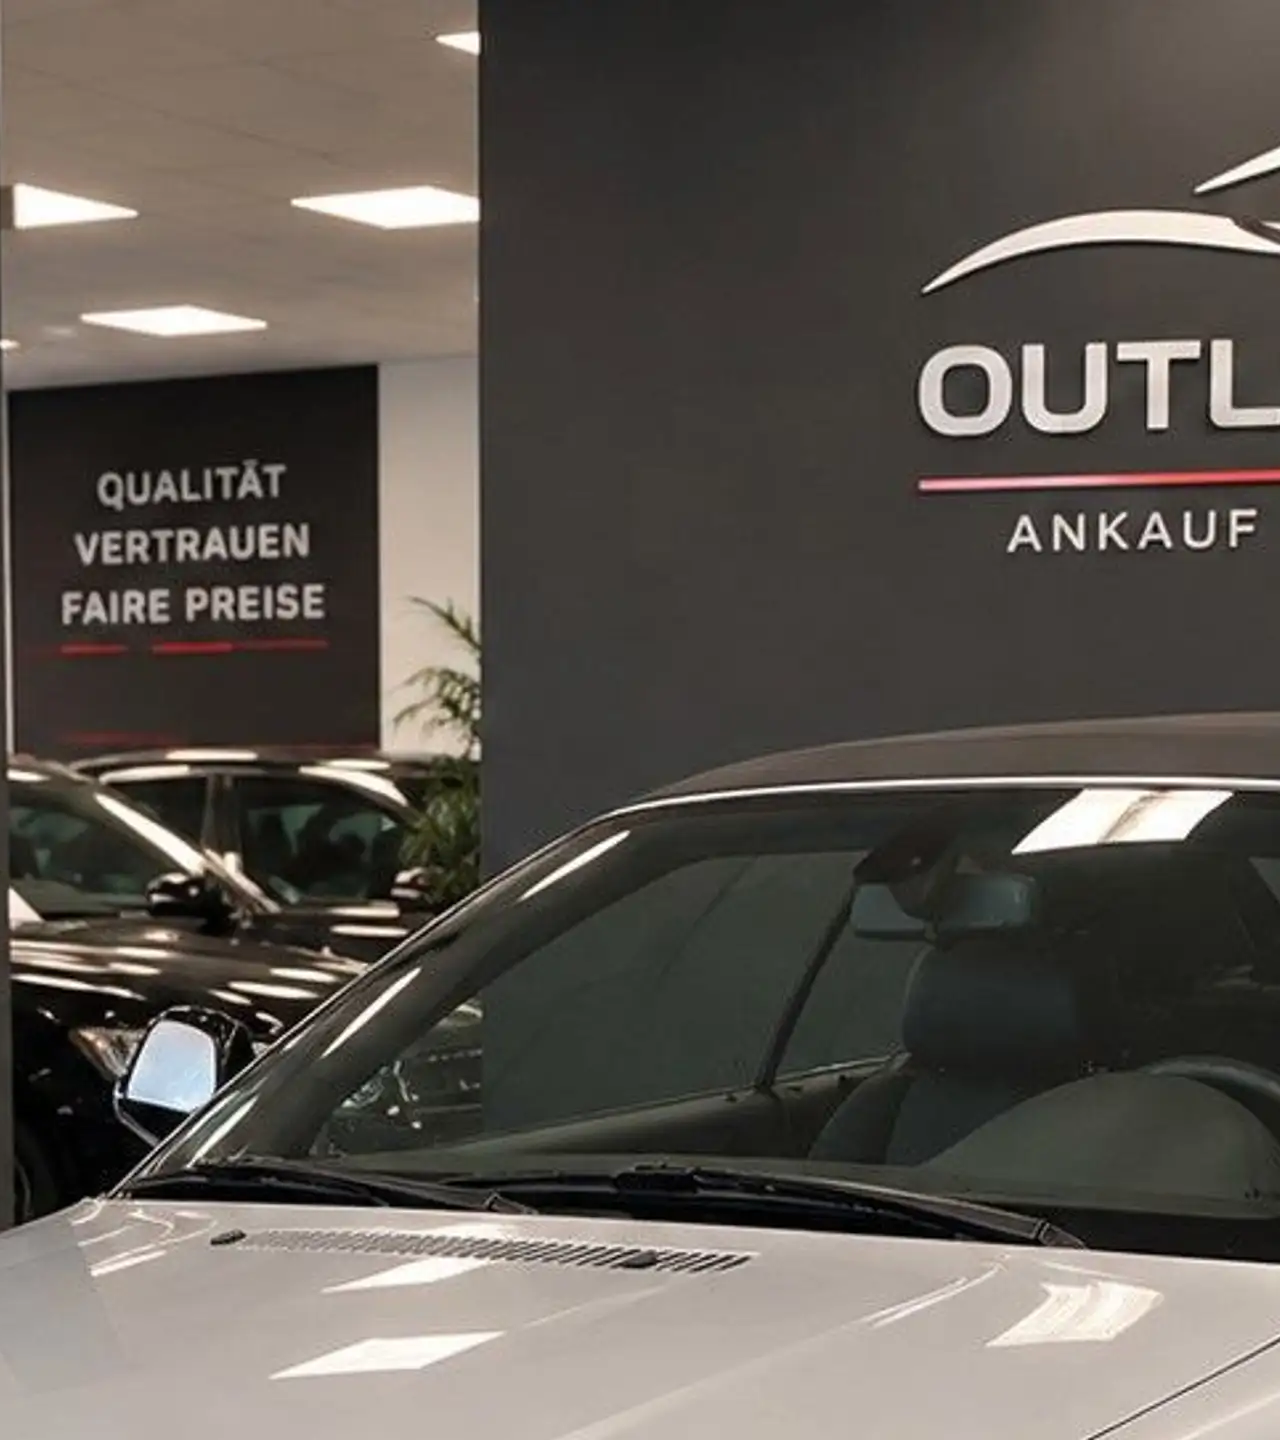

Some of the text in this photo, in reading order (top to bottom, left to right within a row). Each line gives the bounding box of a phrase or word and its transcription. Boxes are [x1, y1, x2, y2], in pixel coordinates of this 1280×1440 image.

[96, 458, 287, 511] QUALITÄT
[74, 523, 310, 566] VERTRAUEN
[1006, 508, 1258, 553] ANKAUF
[61, 583, 325, 626] FAIRE PREISE
